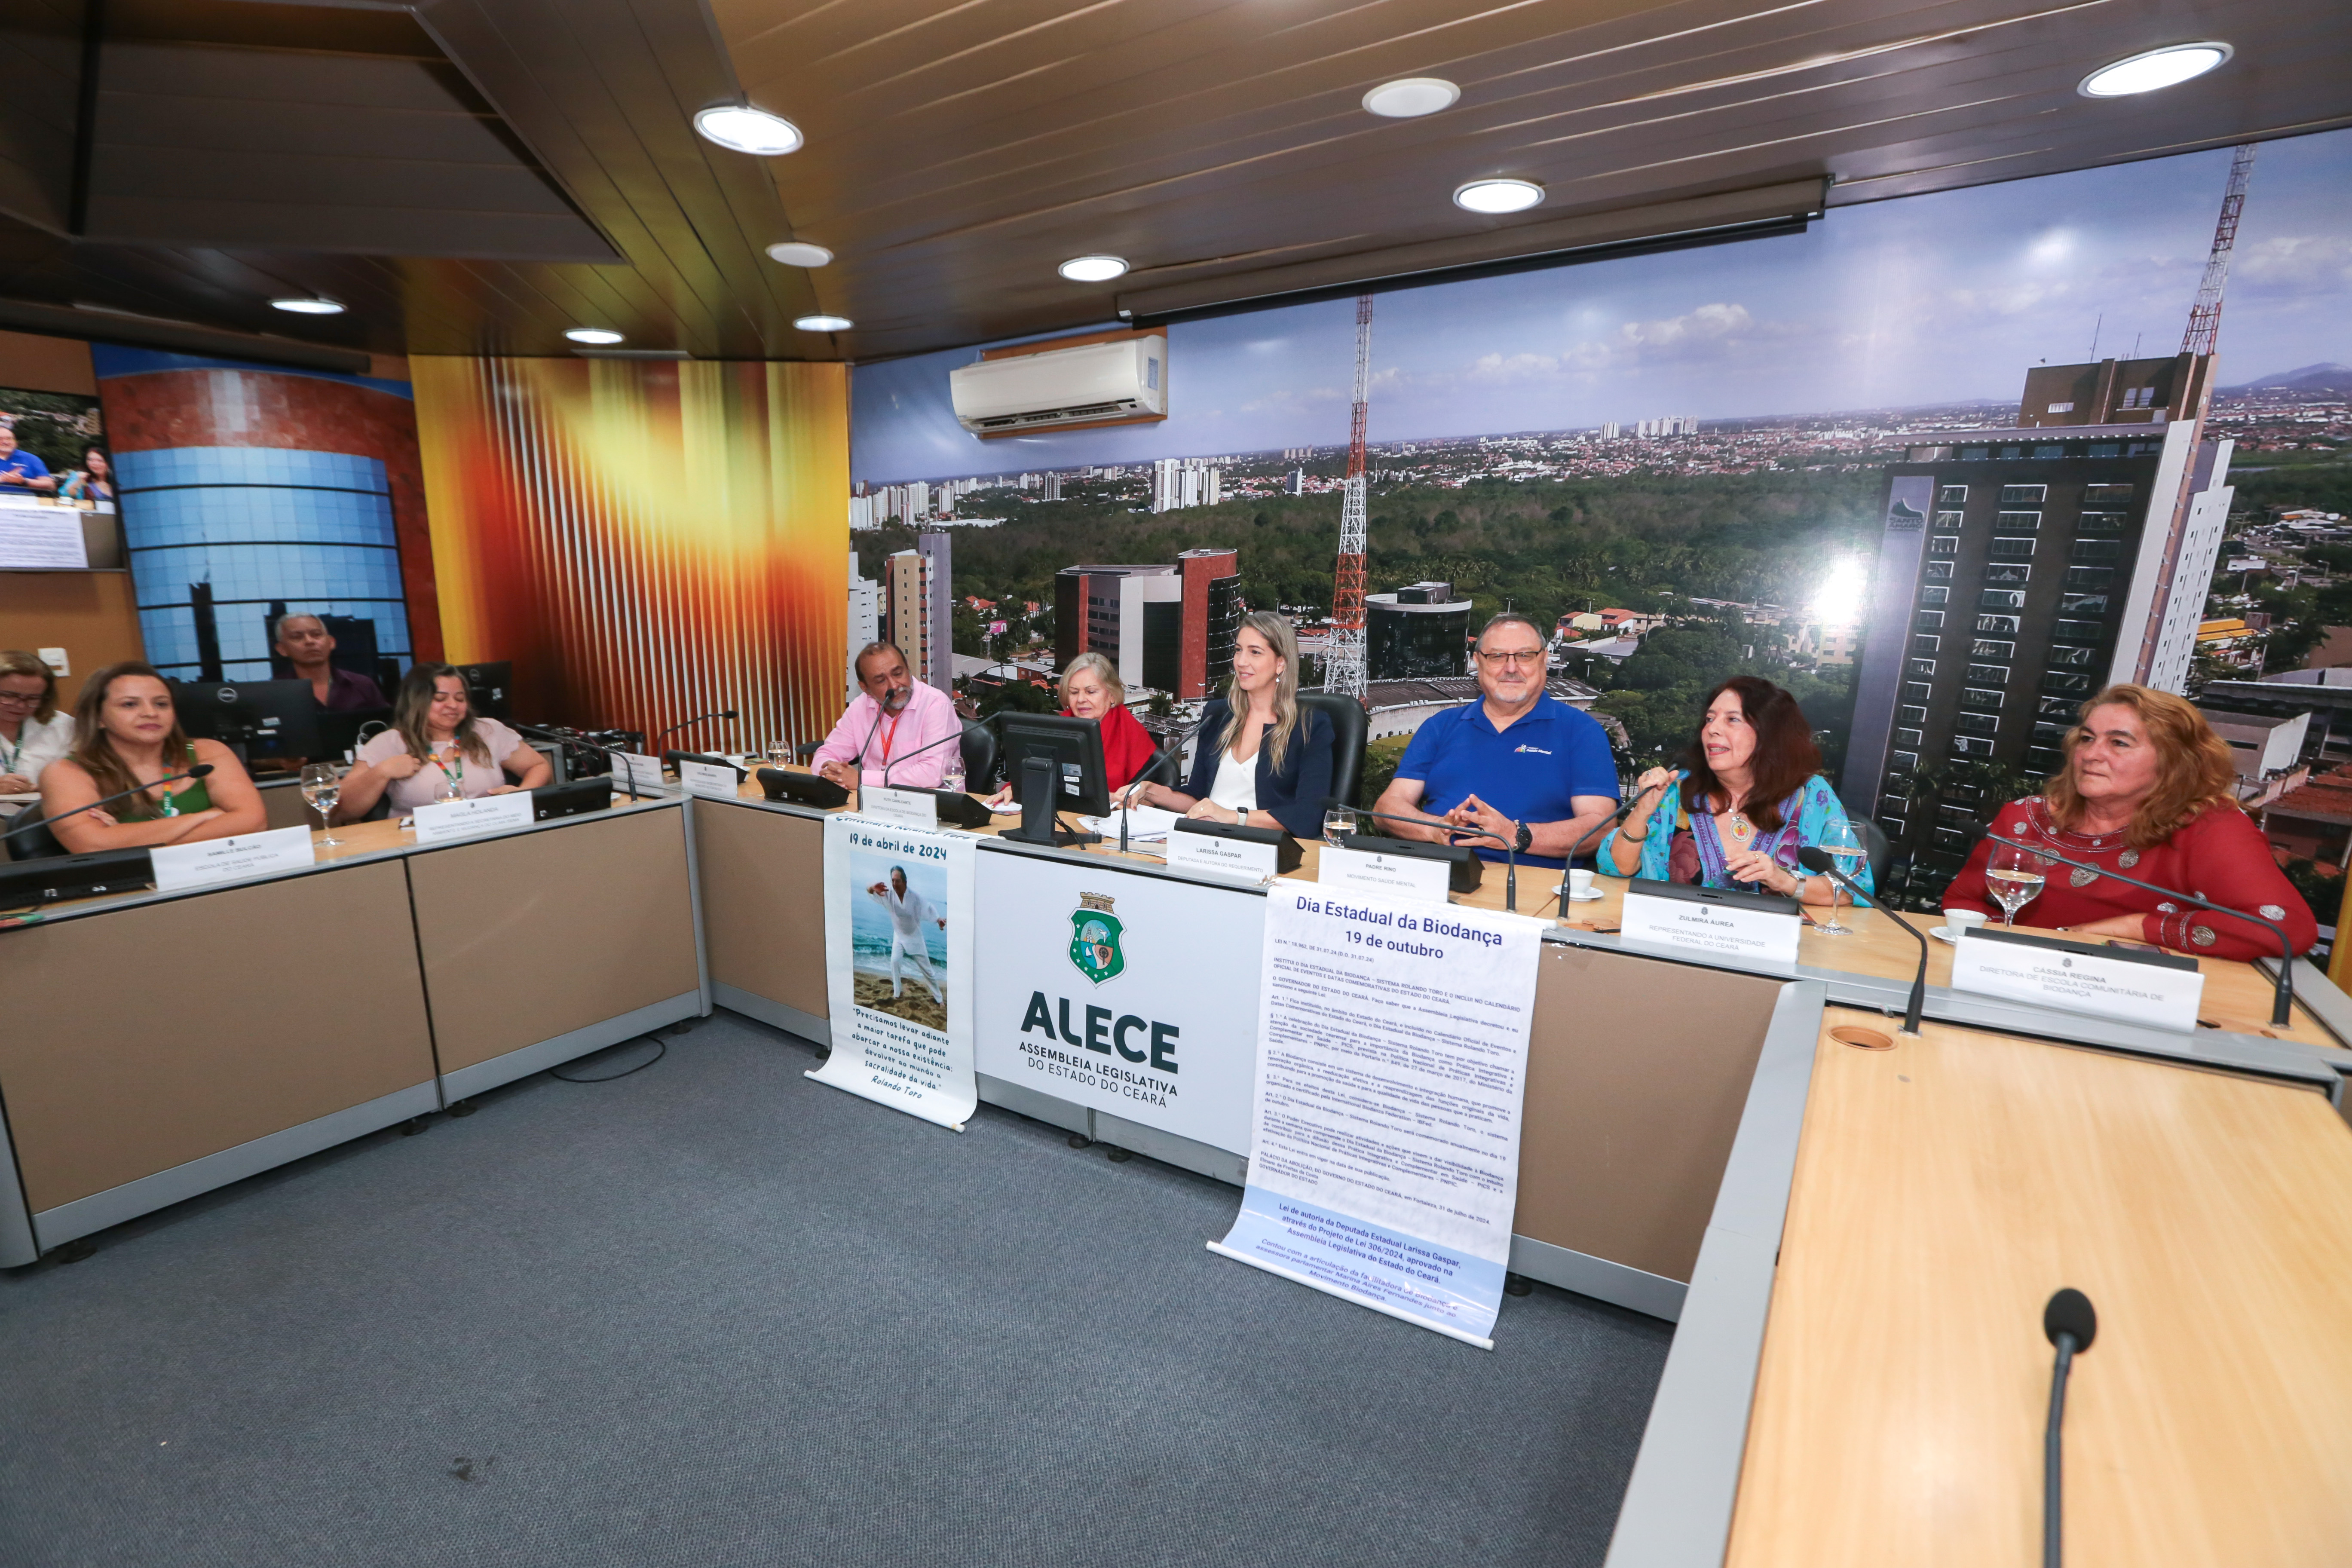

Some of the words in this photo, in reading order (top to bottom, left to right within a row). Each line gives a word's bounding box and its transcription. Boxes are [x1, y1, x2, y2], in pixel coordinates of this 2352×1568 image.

[850, 833, 858, 845] 19
[862, 834, 873, 846] de
[876, 837, 899, 851] abril
[903, 841, 915, 854] de
[919, 844, 946, 860] 2024
[1228, 864, 1263, 873] REQUERIMENTO
[1347, 873, 1377, 882] MOVIMENTO
[1297, 896, 1320, 913] Dia
[1325, 901, 1392, 926] Estadual
[1398, 914, 1417, 930] da
[1423, 918, 1502, 947] Biodança
[1679, 915, 1709, 924] ZULMIRA
[1346, 931, 1361, 943] 19
[1366, 934, 1382, 948] de
[1387, 941, 1443, 959] outubro
[1649, 925, 1707, 938] REPRESENTANDO
[1714, 935, 1766, 947] UNIVERSIDADE
[1672, 935, 1702, 945] FEDERAL
[1715, 942, 1739, 950] CEARÁ
[1979, 965, 2024, 978] DIRETORA
[2041, 976, 2078, 987] ESCOLA
[2080, 982, 2148, 998] COMUNITÁRIA
[2033, 967, 2067, 977] CÁSSIA
[2070, 972, 2106, 983] REGINA
[2043, 984, 2091, 997] BIODANÇA
[853, 1008, 897, 1028] "Precisamos
[900, 1022, 918, 1035] levar
[922, 1031, 949, 1045] adiante
[864, 1025, 884, 1035] maior
[887, 1031, 910, 1044] tarefa
[913, 1042, 926, 1050] que
[929, 1047, 946, 1057] pode
[1020, 991, 1179, 1075] ALECE
[852, 1032, 880, 1047] abarcar
[889, 1046, 910, 1057] nossa
[913, 1054, 952, 1072] existência:
[865, 1047, 895, 1063] devolver
[910, 1064, 934, 1076] mundo
[865, 1060, 906, 1079] sacralidade
[909, 1074, 917, 1083] da
[1019, 1041, 1091, 1071] ASSEMBLEIA
[1096, 1063, 1177, 1096] LEGISLATIVA
[1028, 1057, 1044, 1070] DO
[1049, 1063, 1095, 1086] ESTADO
[1101, 1078, 1118, 1093] DO
[1123, 1086, 1166, 1108] CEARÁ
[871, 1075, 901, 1091] Rolando
[904, 1086, 922, 1098] Toro
[1259, 1163, 1290, 1177] GOVERNADOR
[1299, 1176, 1318, 1185] ESTADO
[1260, 1157, 1276, 1166] Elmano
[1283, 1164, 1298, 1173] Freitas
[1279, 1203, 1289, 1212] Lei
[1300, 1212, 1324, 1223] autoria
[1326, 1218, 1334, 1226] da
[1336, 1221, 1369, 1237] Deputada
[1371, 1232, 1402, 1248] Estadual
[1403, 1243, 1430, 1258] Larissa
[1432, 1253, 1461, 1269] Gaspar,
[1282, 1216, 1307, 1228] através
[1318, 1226, 1343, 1240] Projeto
[1355, 1238, 1366, 1247] Lei
[1368, 1243, 1404, 1261] 306/2024,
[1406, 1257, 1442, 1272] aprovado
[1262, 1238, 1286, 1251] Contou
[1287, 1249, 1302, 1257] com
[1309, 1256, 1348, 1272] articulação
[1287, 1227, 1326, 1245] Assembleia
[1328, 1240, 1366, 1259] Legislativa
[1379, 1257, 1403, 1271] Estado
[1406, 1266, 1415, 1274] do
[1417, 1270, 1440, 1283] Ceará.
[1256, 1245, 1290, 1259] assessora
[1290, 1257, 1334, 1274] parlamentar
[1335, 1271, 1360, 1284] Marina
[1362, 1281, 1381, 1291] Aires
[1383, 1288, 1423, 1305] Fernandes
[1424, 1303, 1444, 1313] junto
[1309, 1270, 1349, 1287] Movimento
[1351, 1284, 1385, 1301] Biodança.
